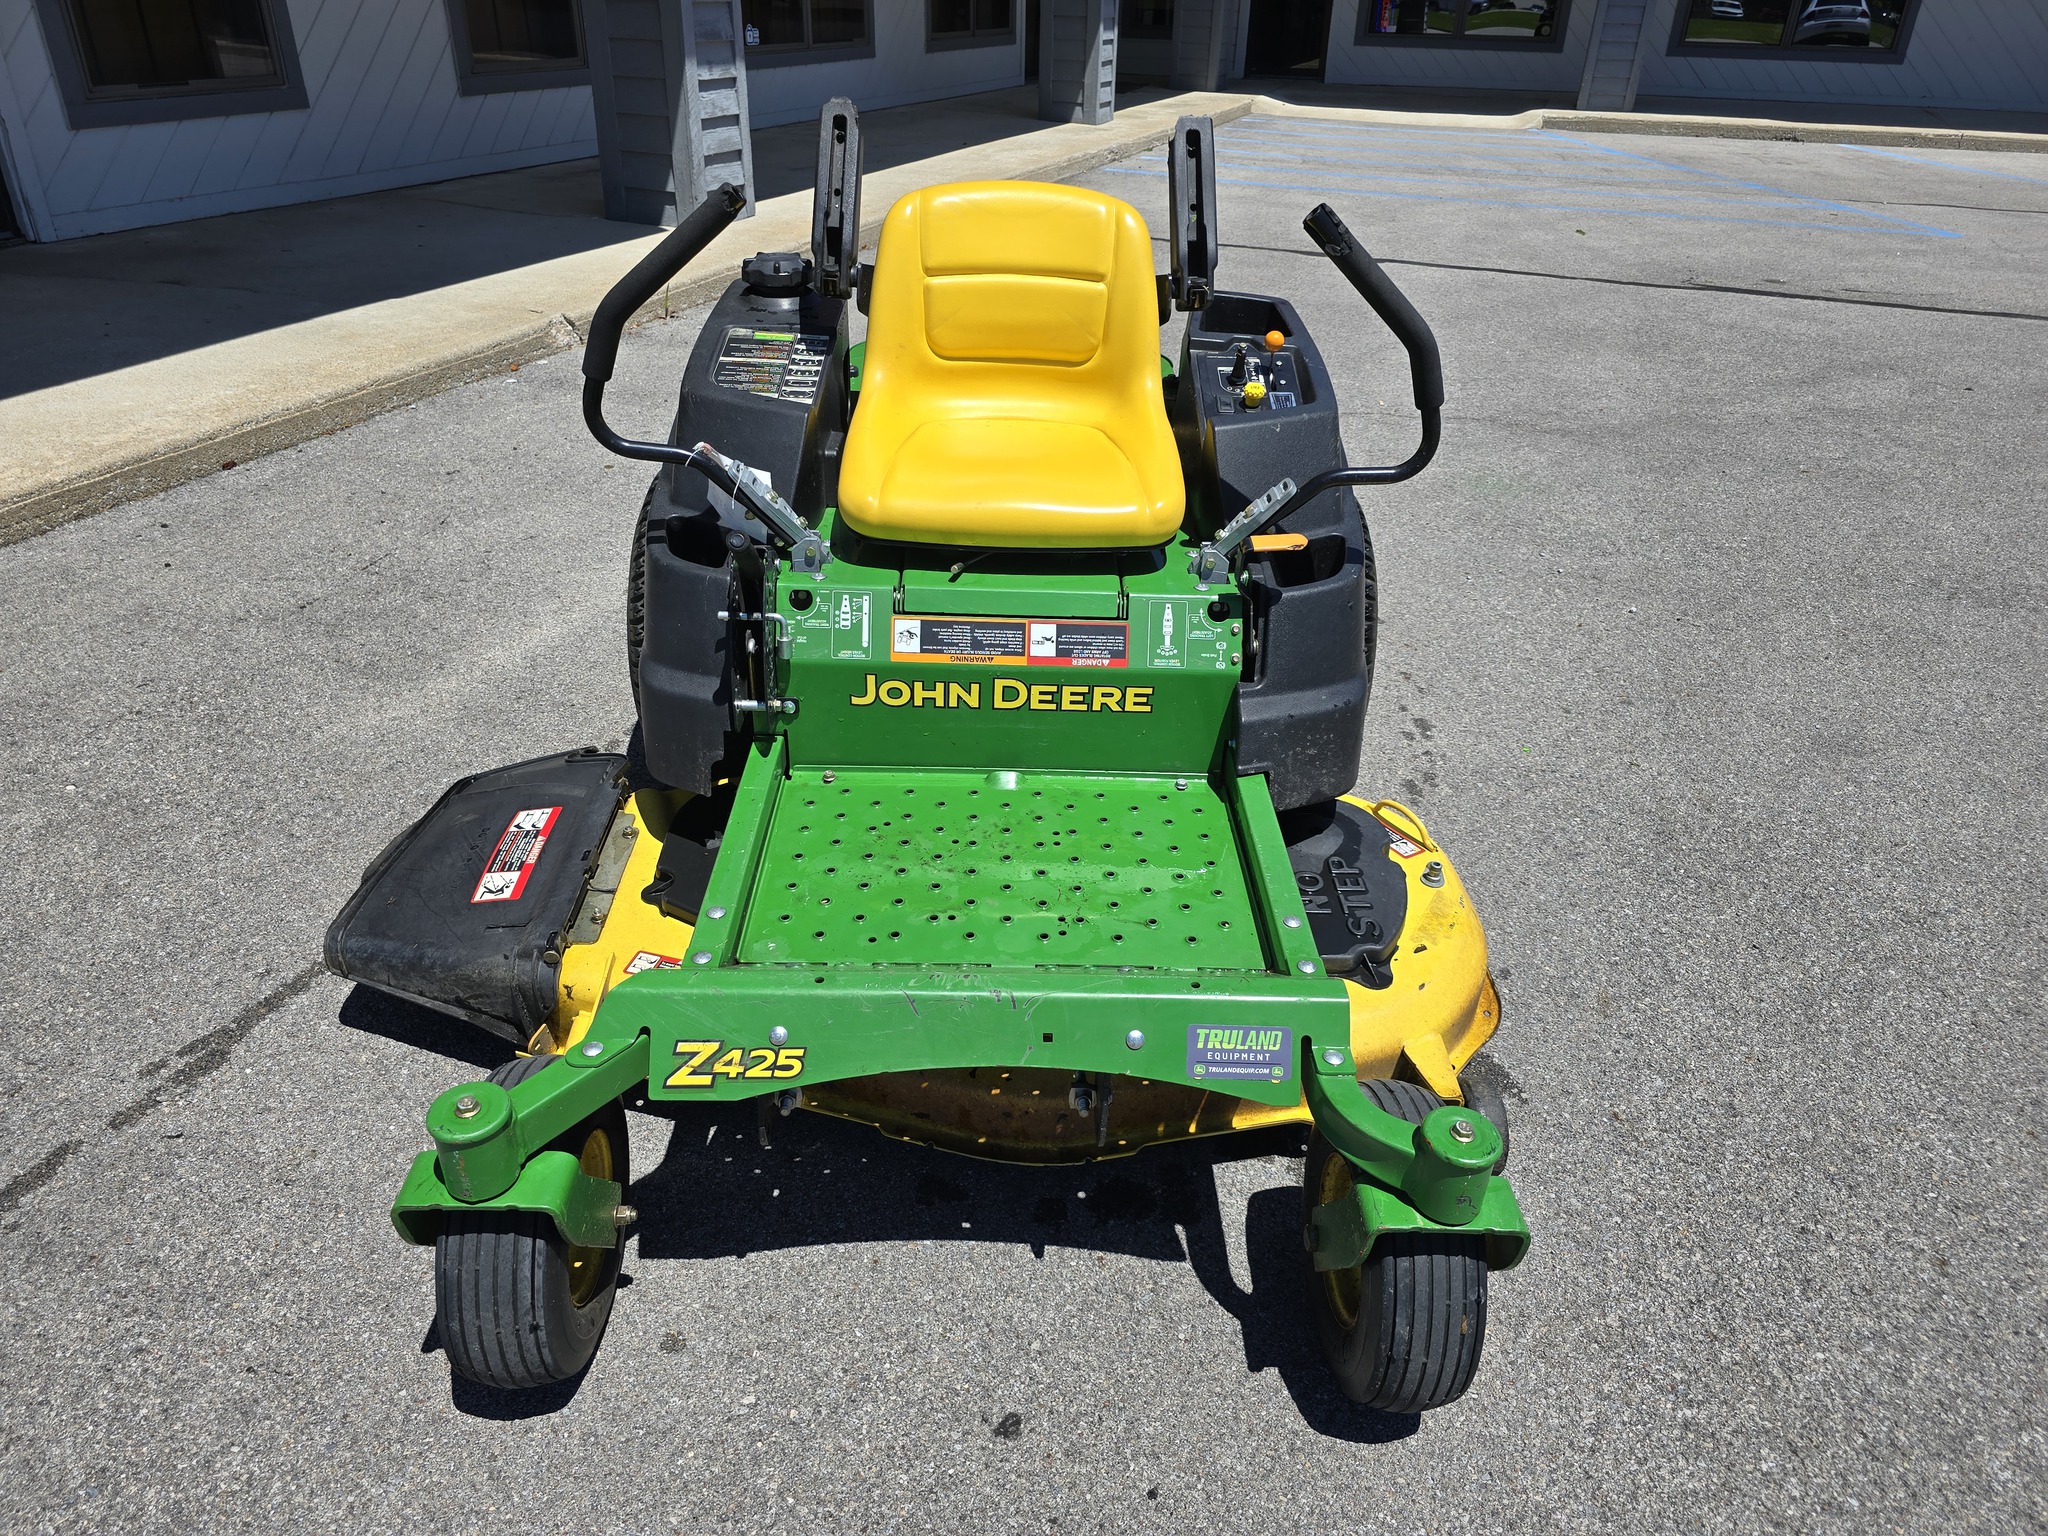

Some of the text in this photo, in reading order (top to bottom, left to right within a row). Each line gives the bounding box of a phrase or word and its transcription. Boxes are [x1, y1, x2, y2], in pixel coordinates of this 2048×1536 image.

[850, 673, 1154, 713] JOHN DEERE
[525, 841, 545, 864] DANGER
[1329, 856, 1380, 936] STEP
[1196, 1029, 1282, 1050] TRULAND
[663, 1040, 807, 1088] Z425
[1208, 1052, 1270, 1061] EQUIPMENT
